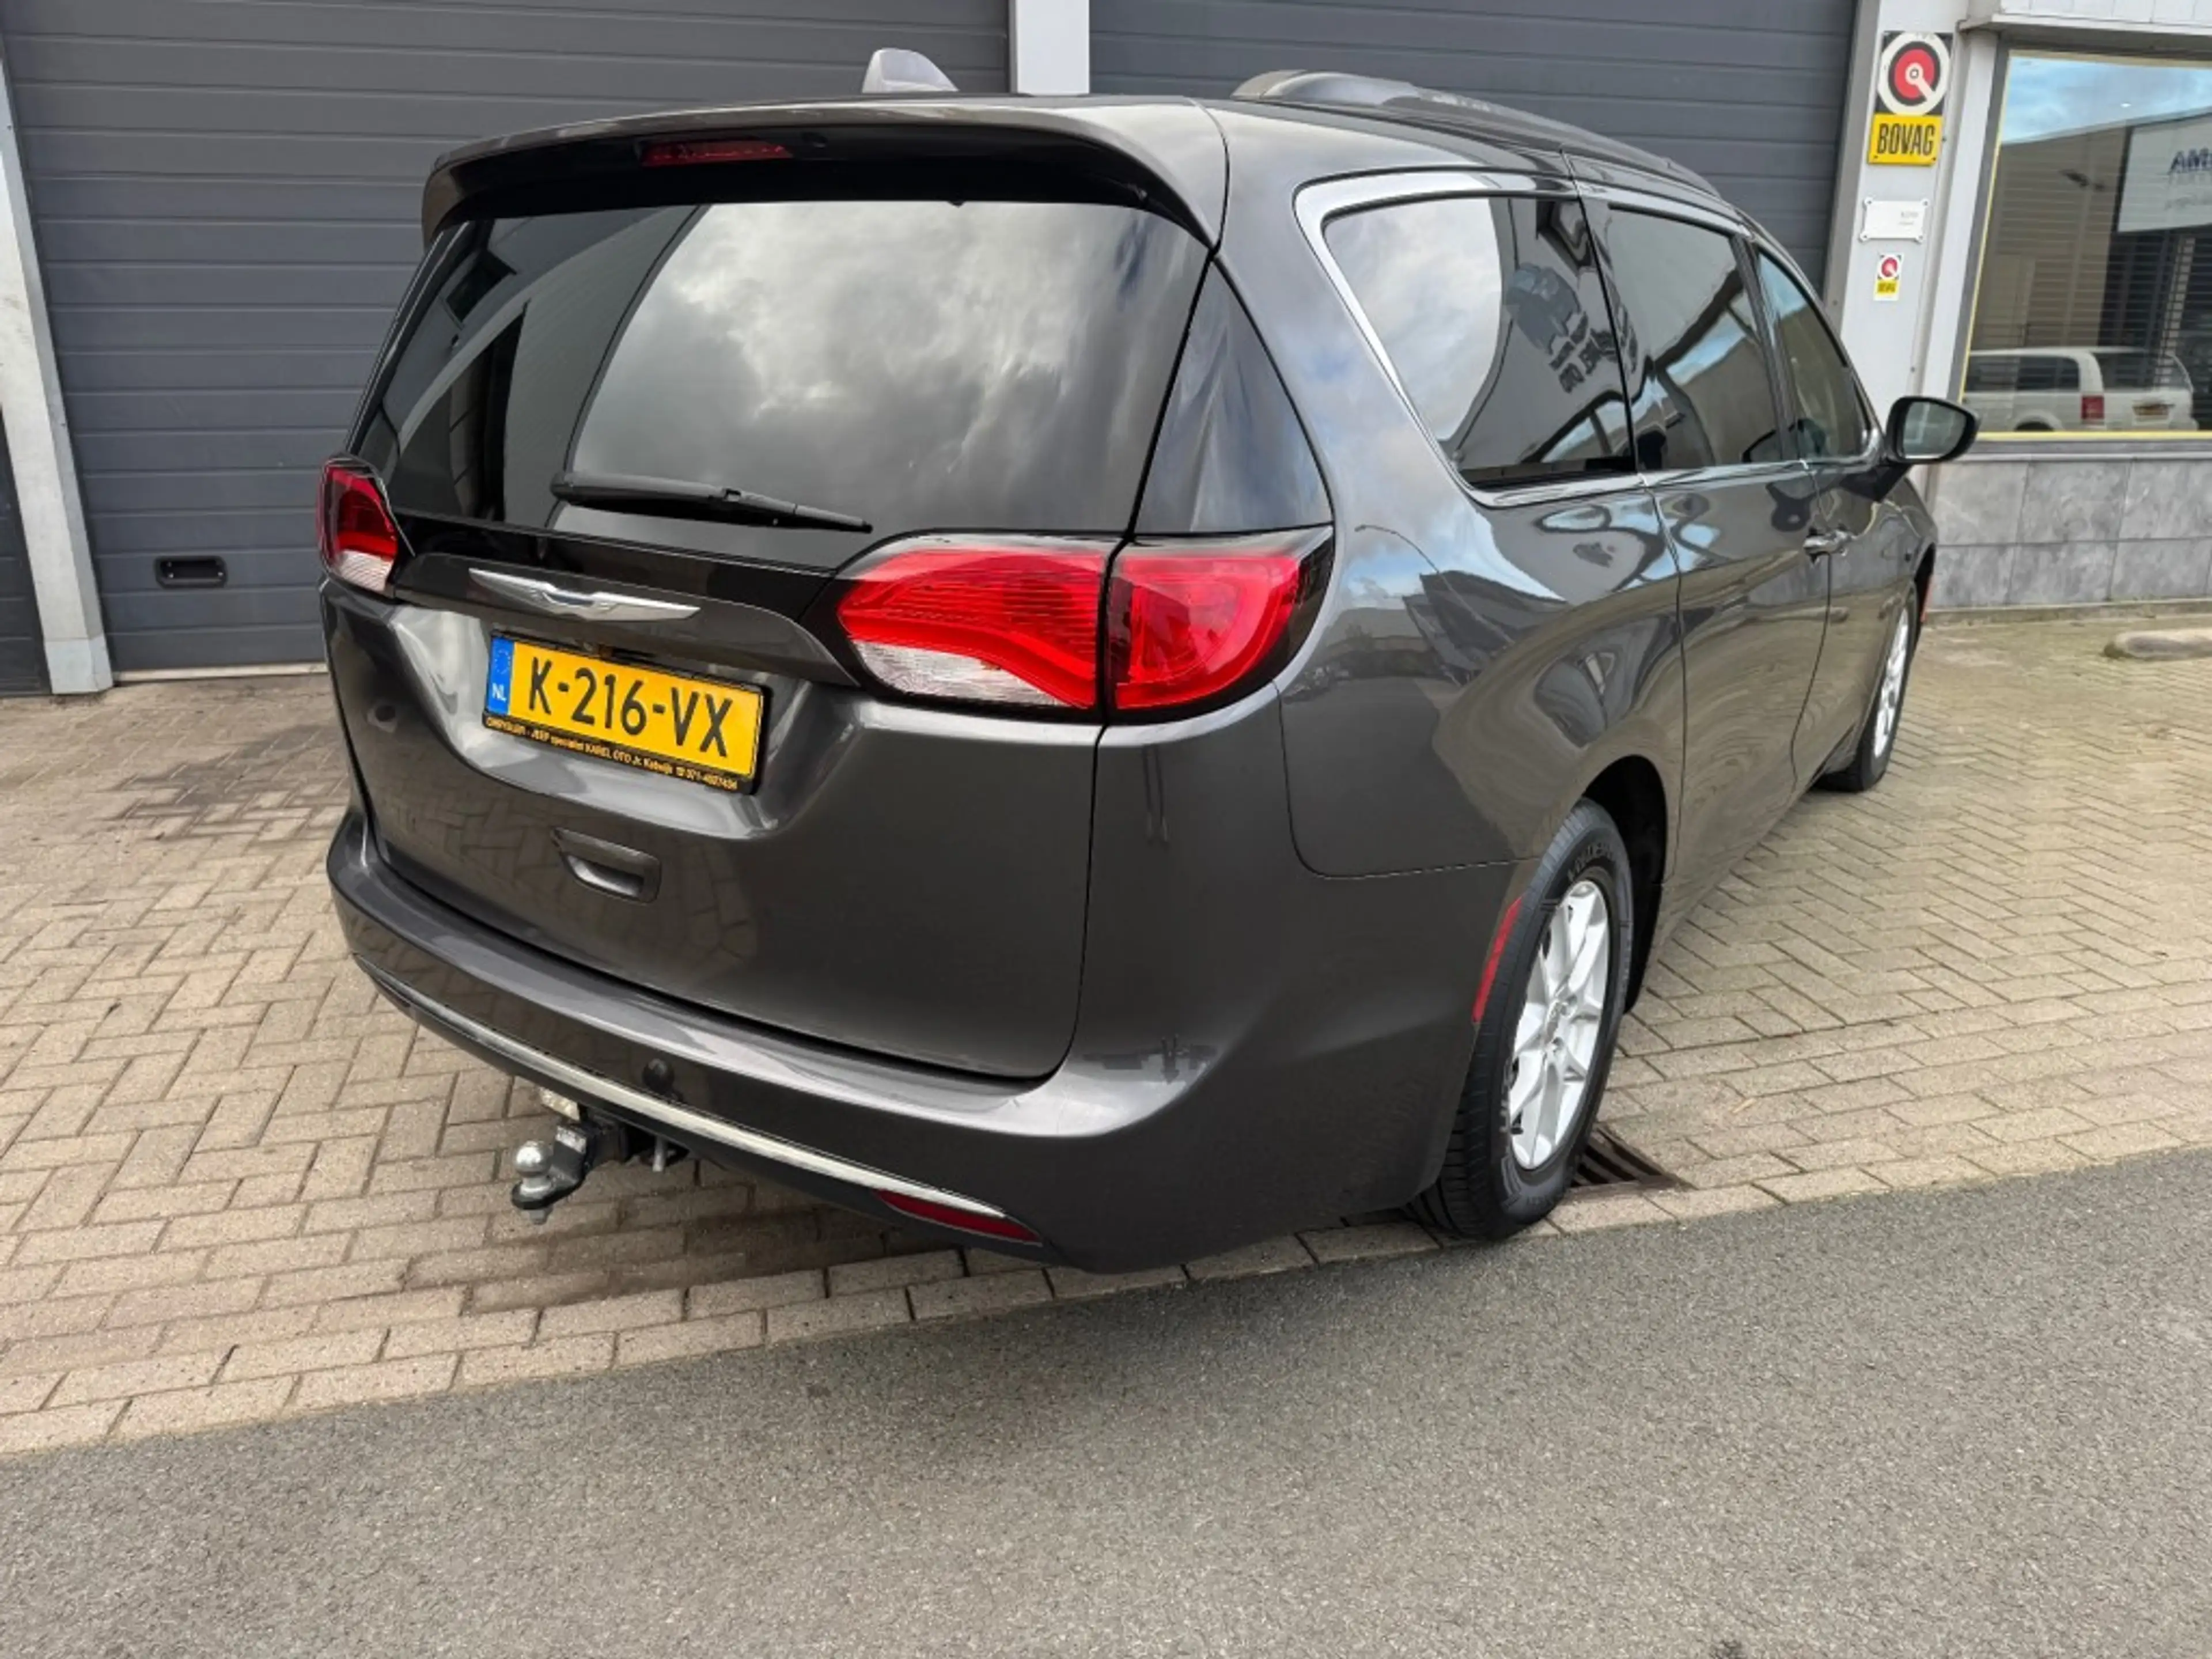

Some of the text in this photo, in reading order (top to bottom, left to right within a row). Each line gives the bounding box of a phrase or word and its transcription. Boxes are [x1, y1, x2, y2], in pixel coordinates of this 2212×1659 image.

[1877, 123, 1936, 156] BOVAG
[492, 683, 506, 702] NL
[529, 657, 733, 757] K-216-VX
